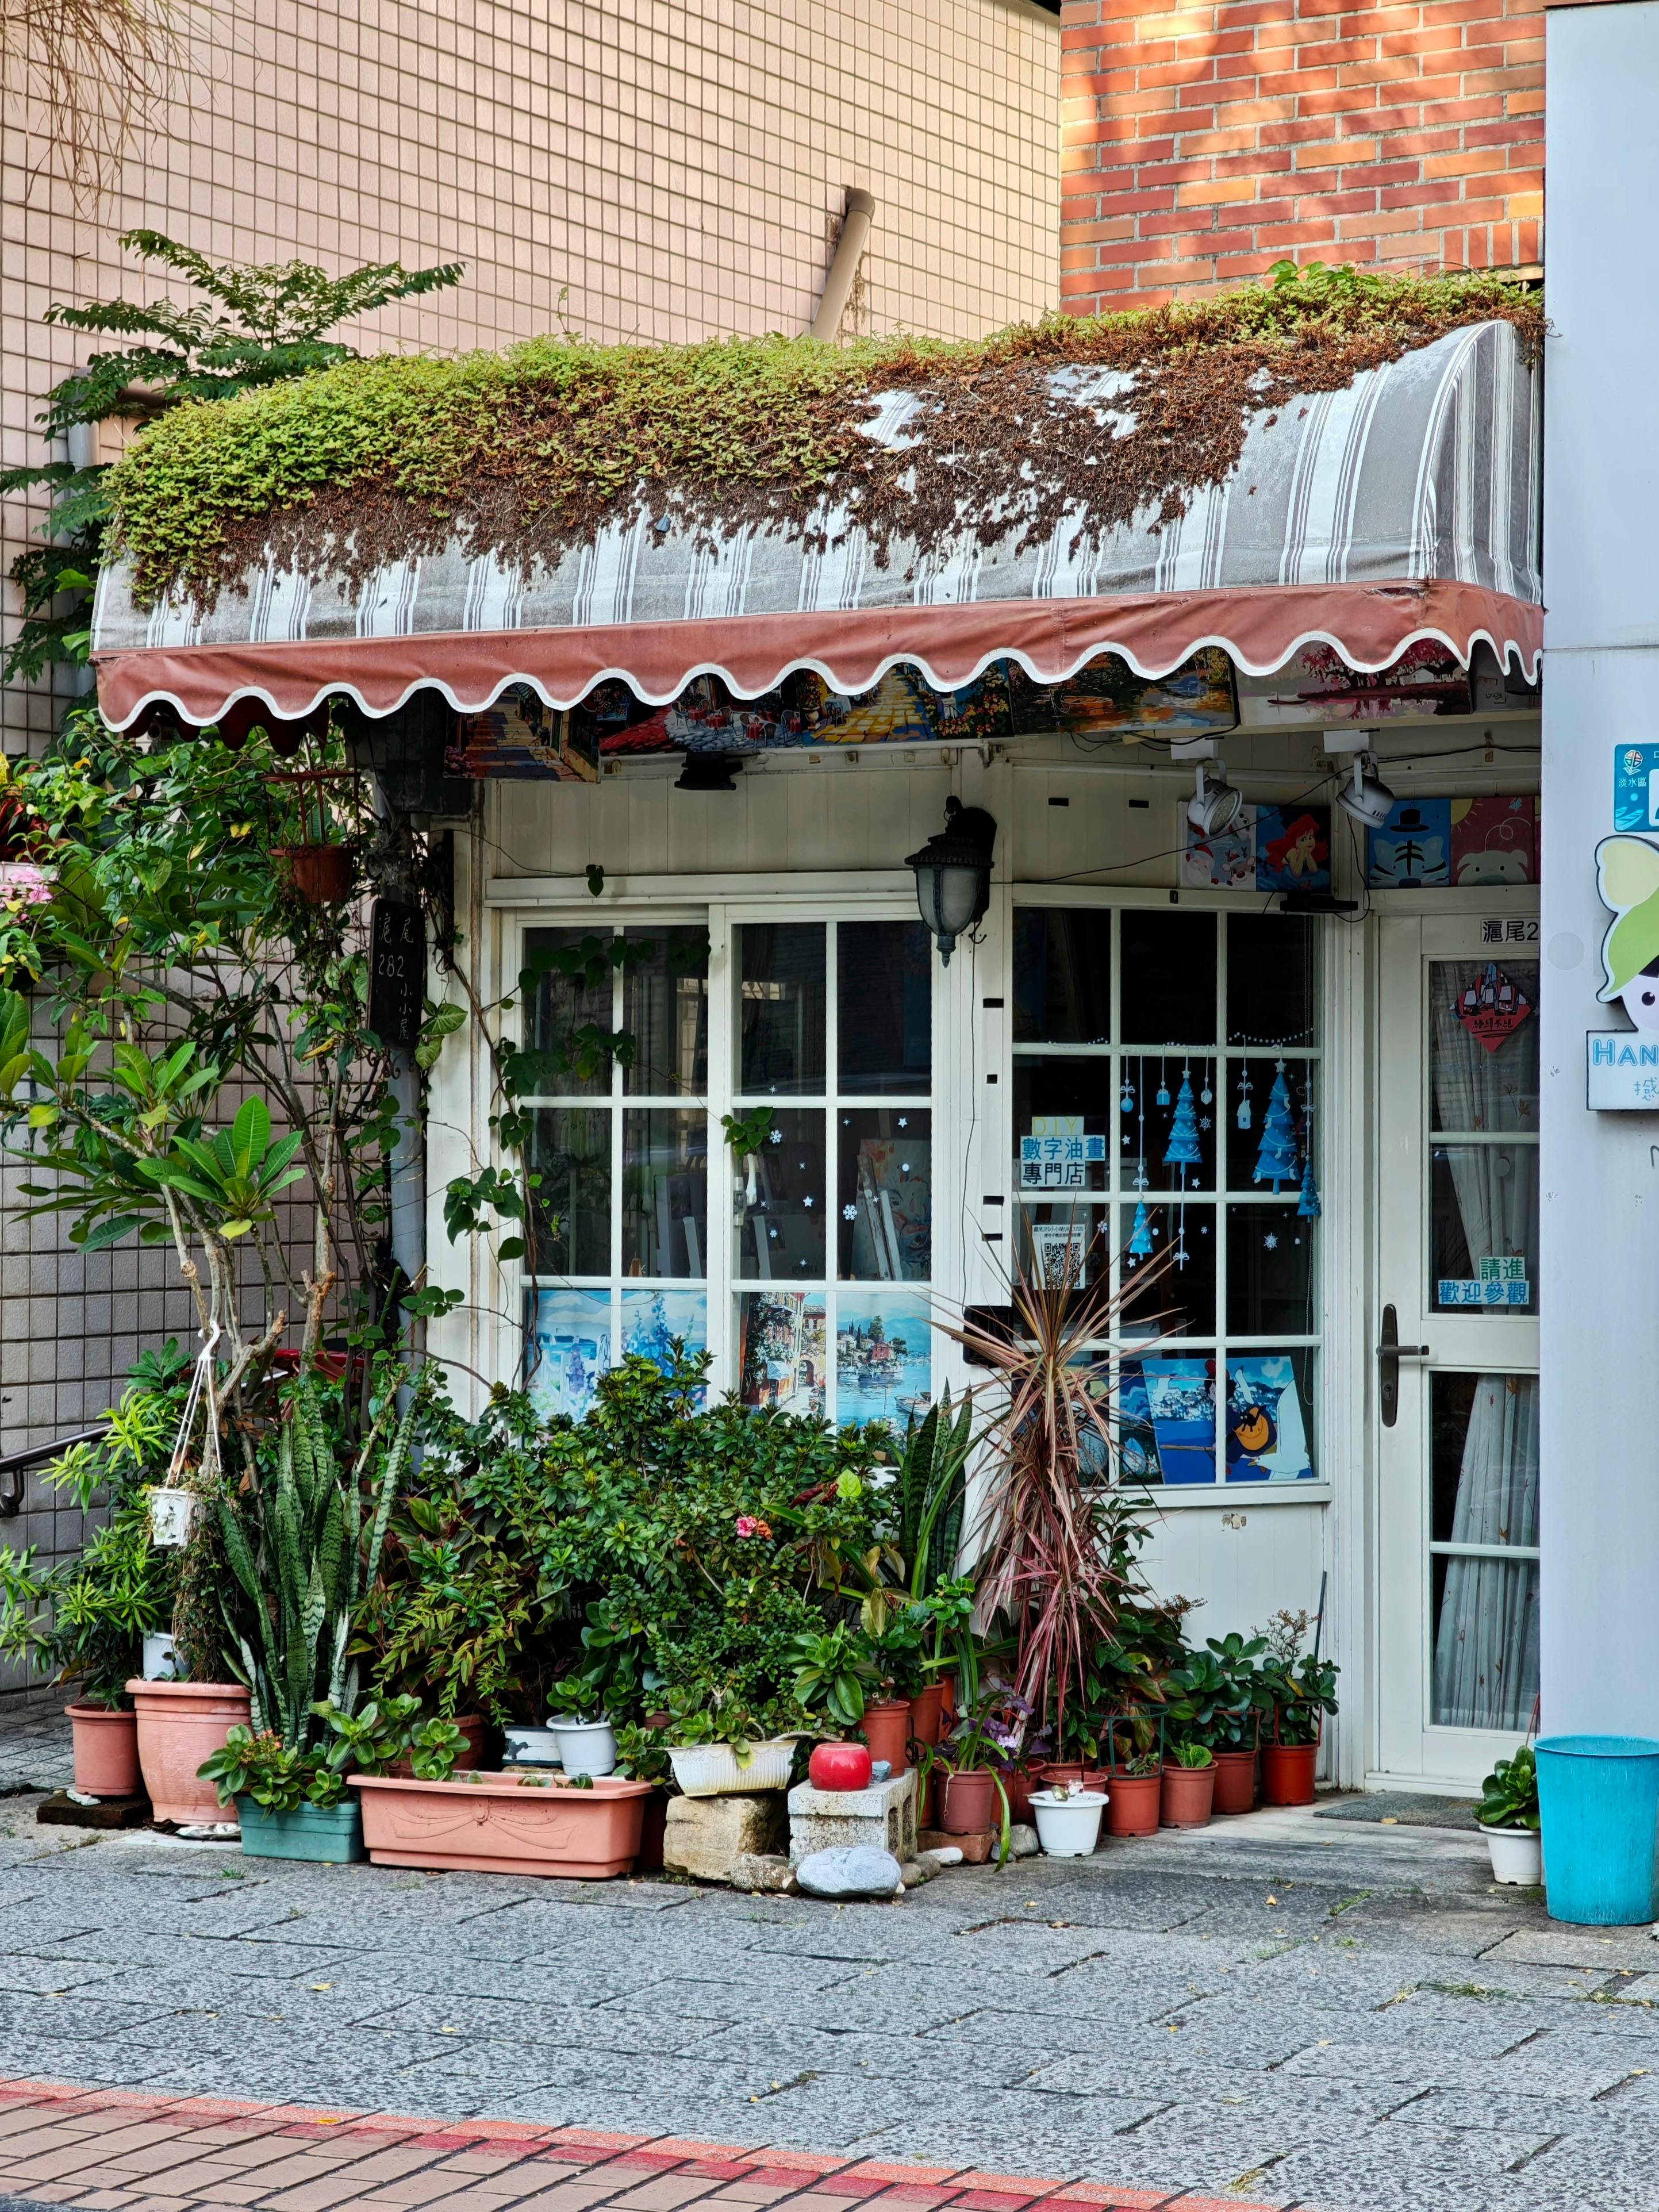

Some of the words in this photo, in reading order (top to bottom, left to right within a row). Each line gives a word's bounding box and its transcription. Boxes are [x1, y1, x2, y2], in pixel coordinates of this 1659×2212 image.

[1618, 777, 1647, 788] 淡水區
[1483, 920, 1539, 943] 滬尾2
[379, 953, 405, 978] 282
[398, 982, 413, 1040] 小小屋
[1022, 1137, 1104, 1160] 數字油畫
[1023, 1162, 1084, 1185] 專門店
[1480, 1258, 1524, 1281] 請進
[1439, 1281, 1527, 1304] 歡迎參觀
